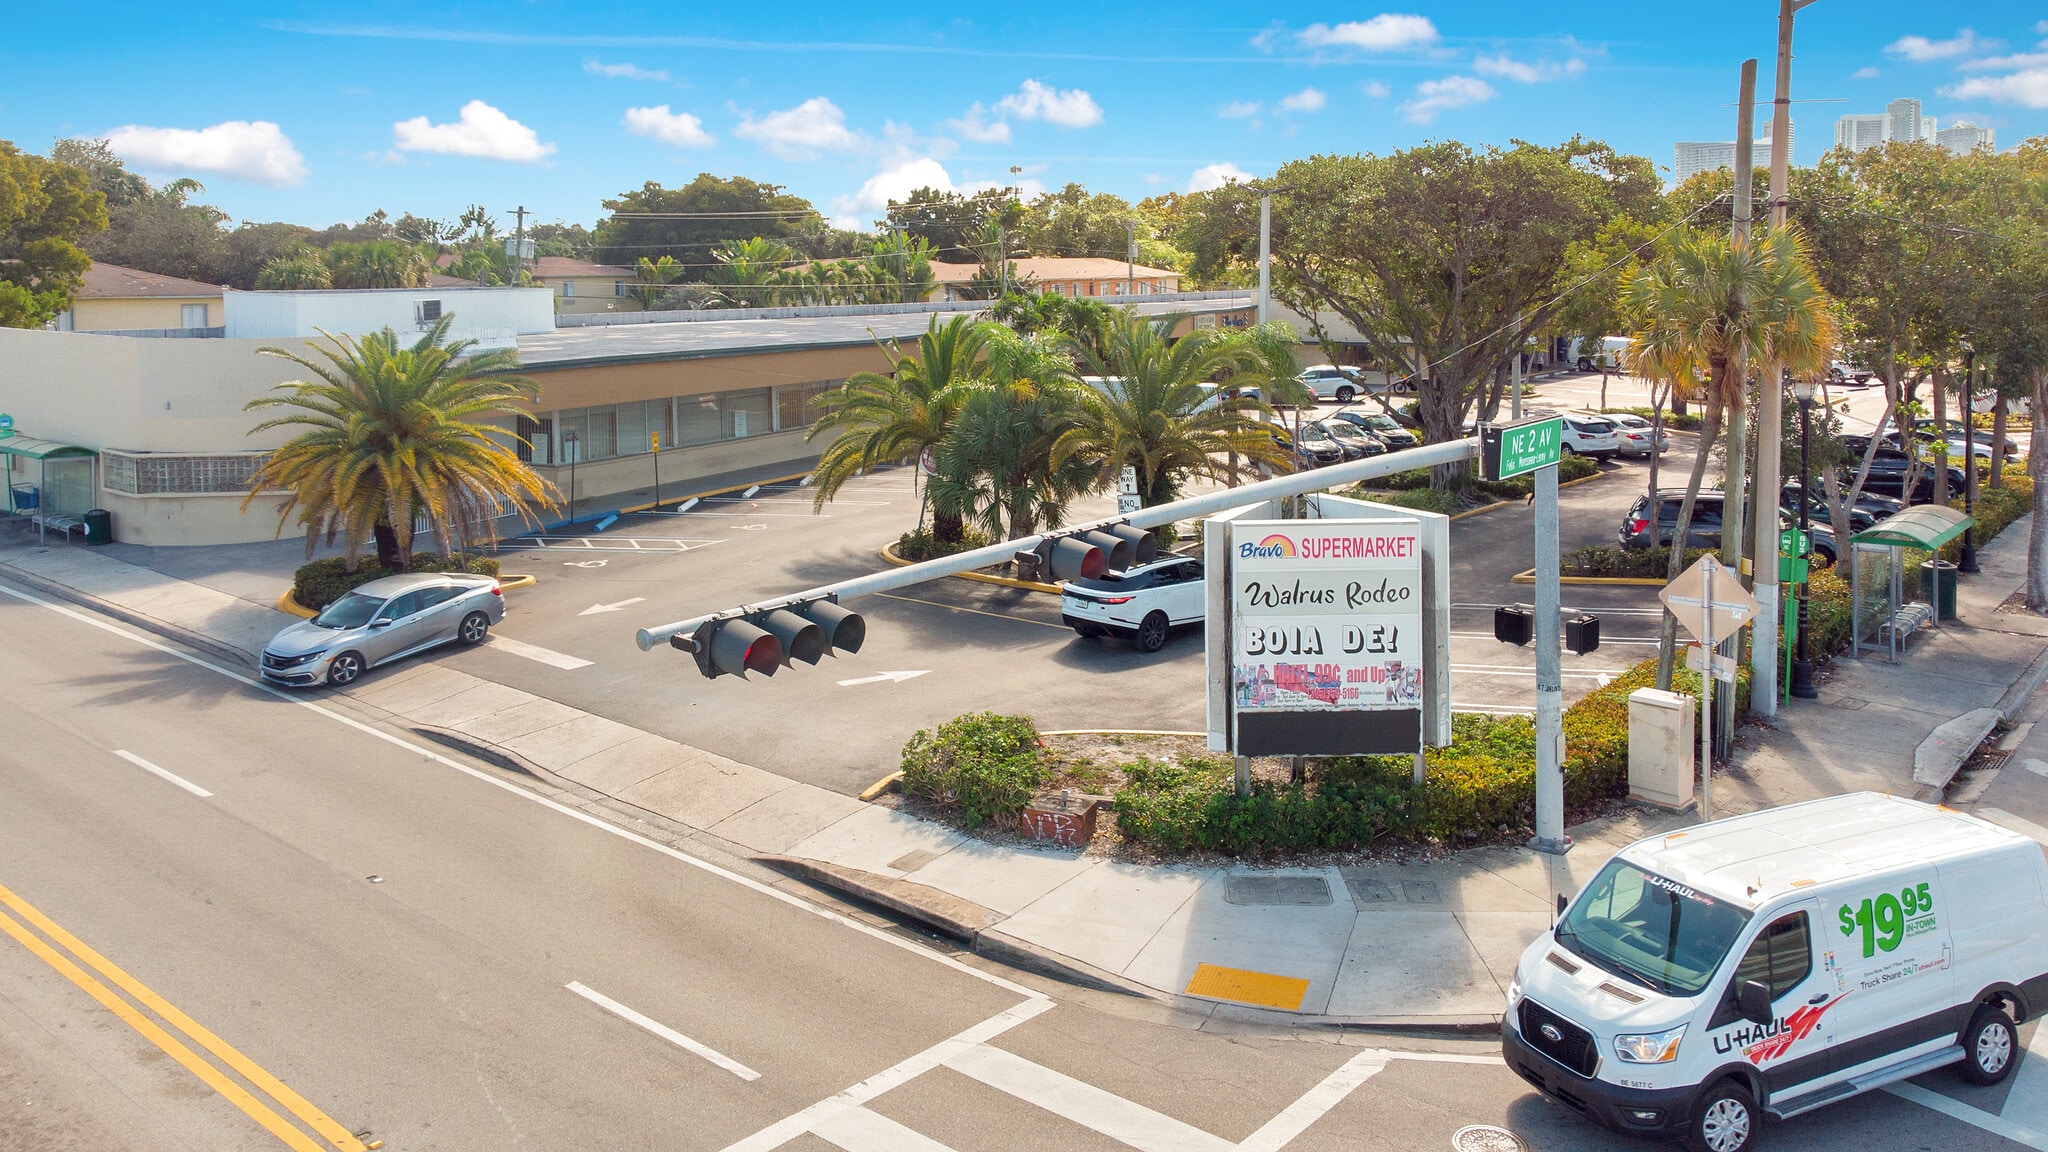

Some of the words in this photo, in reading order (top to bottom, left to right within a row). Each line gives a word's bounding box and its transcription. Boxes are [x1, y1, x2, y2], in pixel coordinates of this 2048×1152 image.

[1512, 434, 1525, 455] NE
[1528, 429, 1536, 453] 2
[1539, 427, 1552, 448] AV
[1124, 499, 1135, 507] NO
[1239, 542, 1284, 559] Bravo
[1301, 537, 1416, 558] SUPERMARKET
[1244, 579, 1335, 607] Walrus
[1346, 578, 1411, 609] Rodeo
[1246, 625, 1323, 655] BOIA
[1342, 624, 1398, 653] DE!
[1347, 666, 1368, 683] and
[1371, 666, 1386, 684] Up
[1650, 876, 1695, 899] U-HAUL
[1906, 917, 1936, 932] IN-TOWN
[1860, 977, 1881, 990] Truck
[1881, 971, 1901, 983] Share
[1903, 963, 1918, 976] 24/7
[1918, 958, 1945, 971] uhaul.com
[1713, 1016, 1791, 1054] U-HAUL
